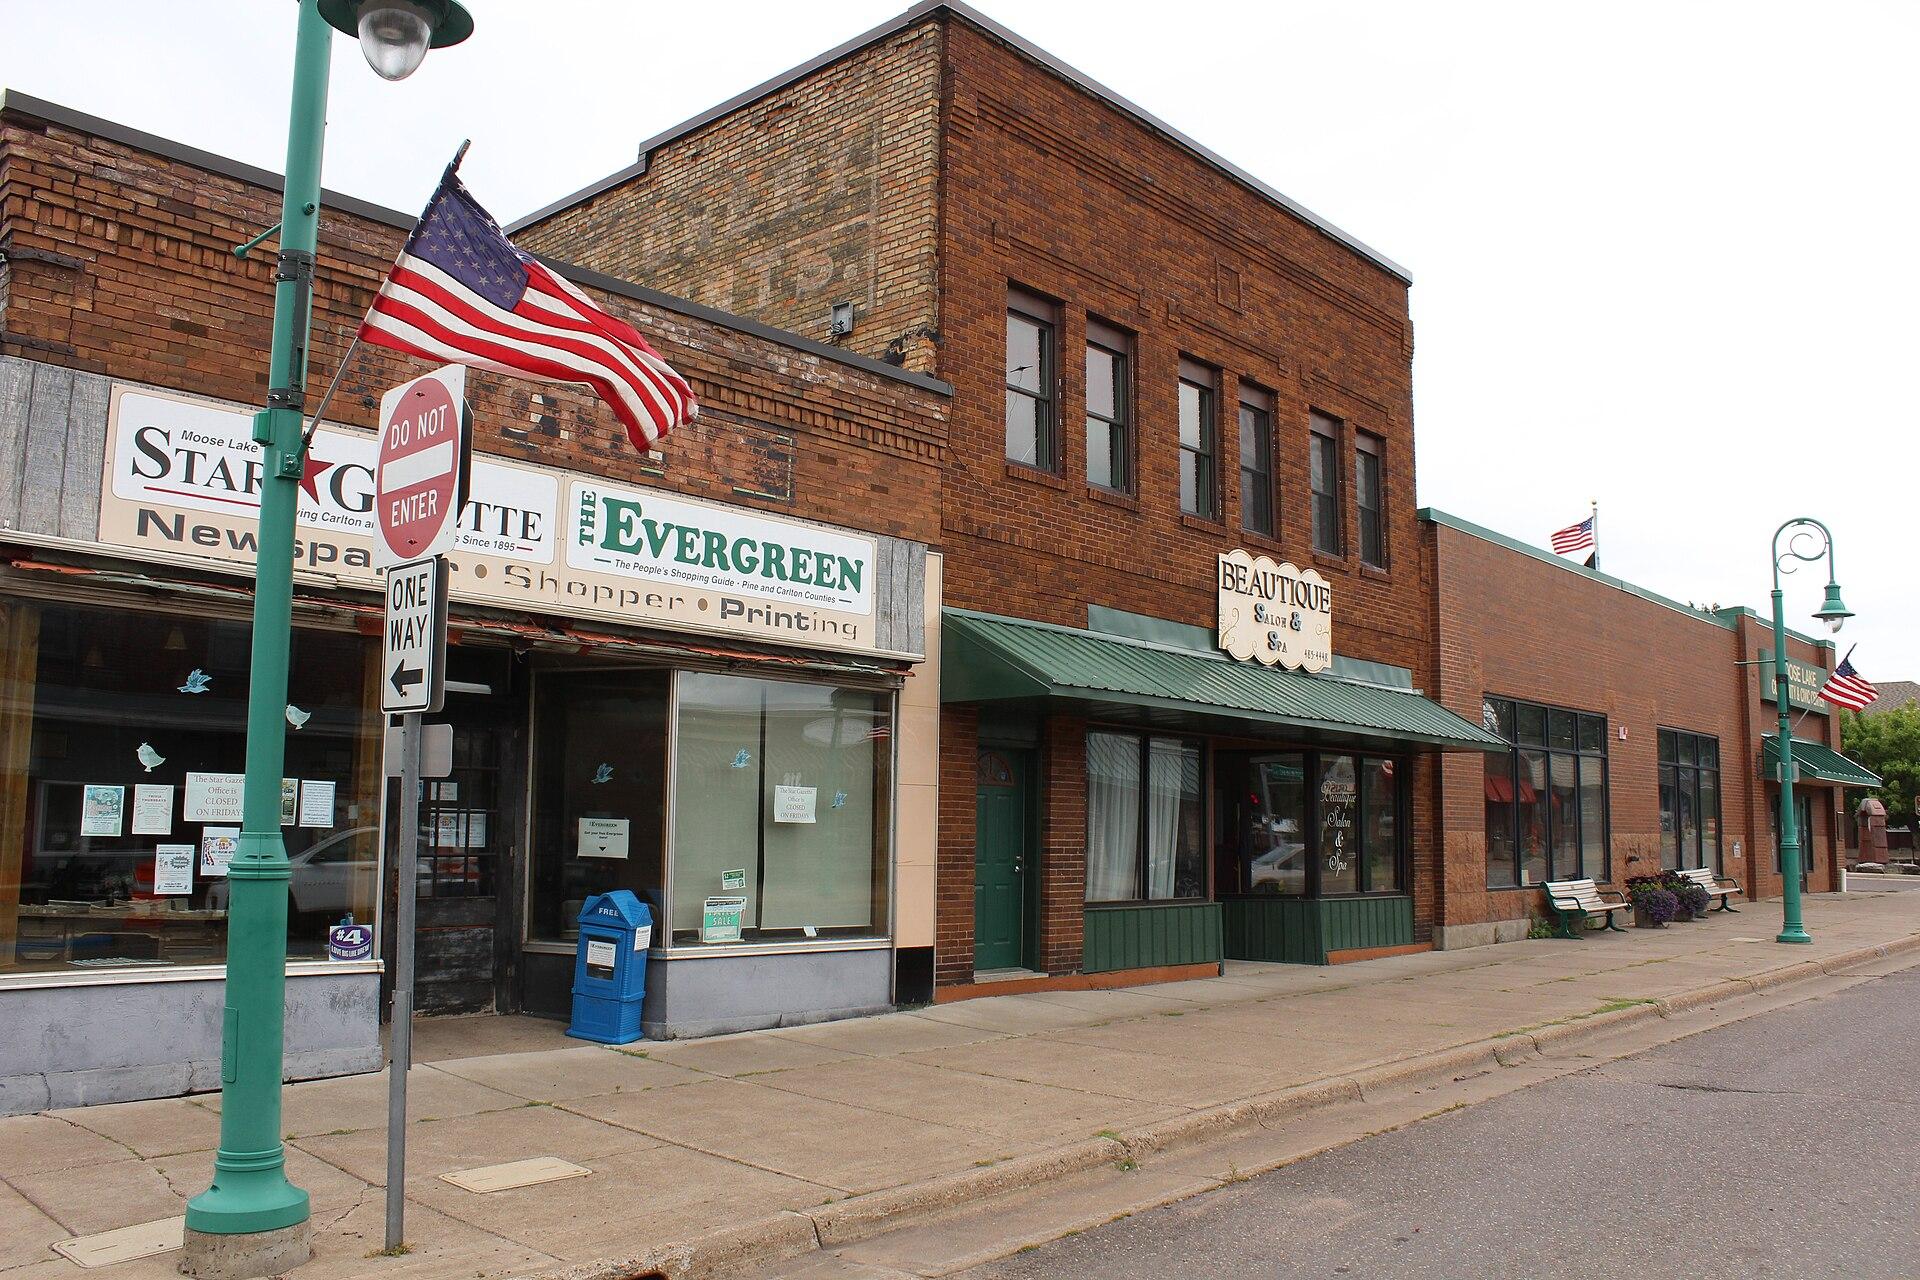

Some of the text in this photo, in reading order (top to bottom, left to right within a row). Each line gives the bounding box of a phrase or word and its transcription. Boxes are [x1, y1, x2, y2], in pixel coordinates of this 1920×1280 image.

[391, 404, 447, 450] DO NOT
[181, 430, 258, 453] Moose Lake
[322, 512, 362, 526] Carlton
[391, 489, 438, 528] ENTER
[462, 534, 490, 547] Since
[494, 541, 515, 551] 1895
[579, 490, 864, 593] THE EVERGREEN
[392, 573, 428, 611] ONE
[615, 559, 836, 604] The People's Shopping Guide Pine and Carlton Counties
[1221, 560, 1330, 614] BEAUTIQUE
[504, 565, 685, 610] Shopper
[720, 597, 857, 640] Printing
[1254, 603, 1302, 632] SALON &
[390, 614, 428, 652] WAY
[1268, 631, 1287, 653] SPA
[196, 808, 209, 816] ON
[205, 797, 238, 806] CLOSED
[1327, 805, 1351, 828] Salon
[1335, 830, 1344, 848] &
[1329, 848, 1348, 878] Spa
[598, 907, 619, 917] FREE
[336, 929, 364, 945] #4
